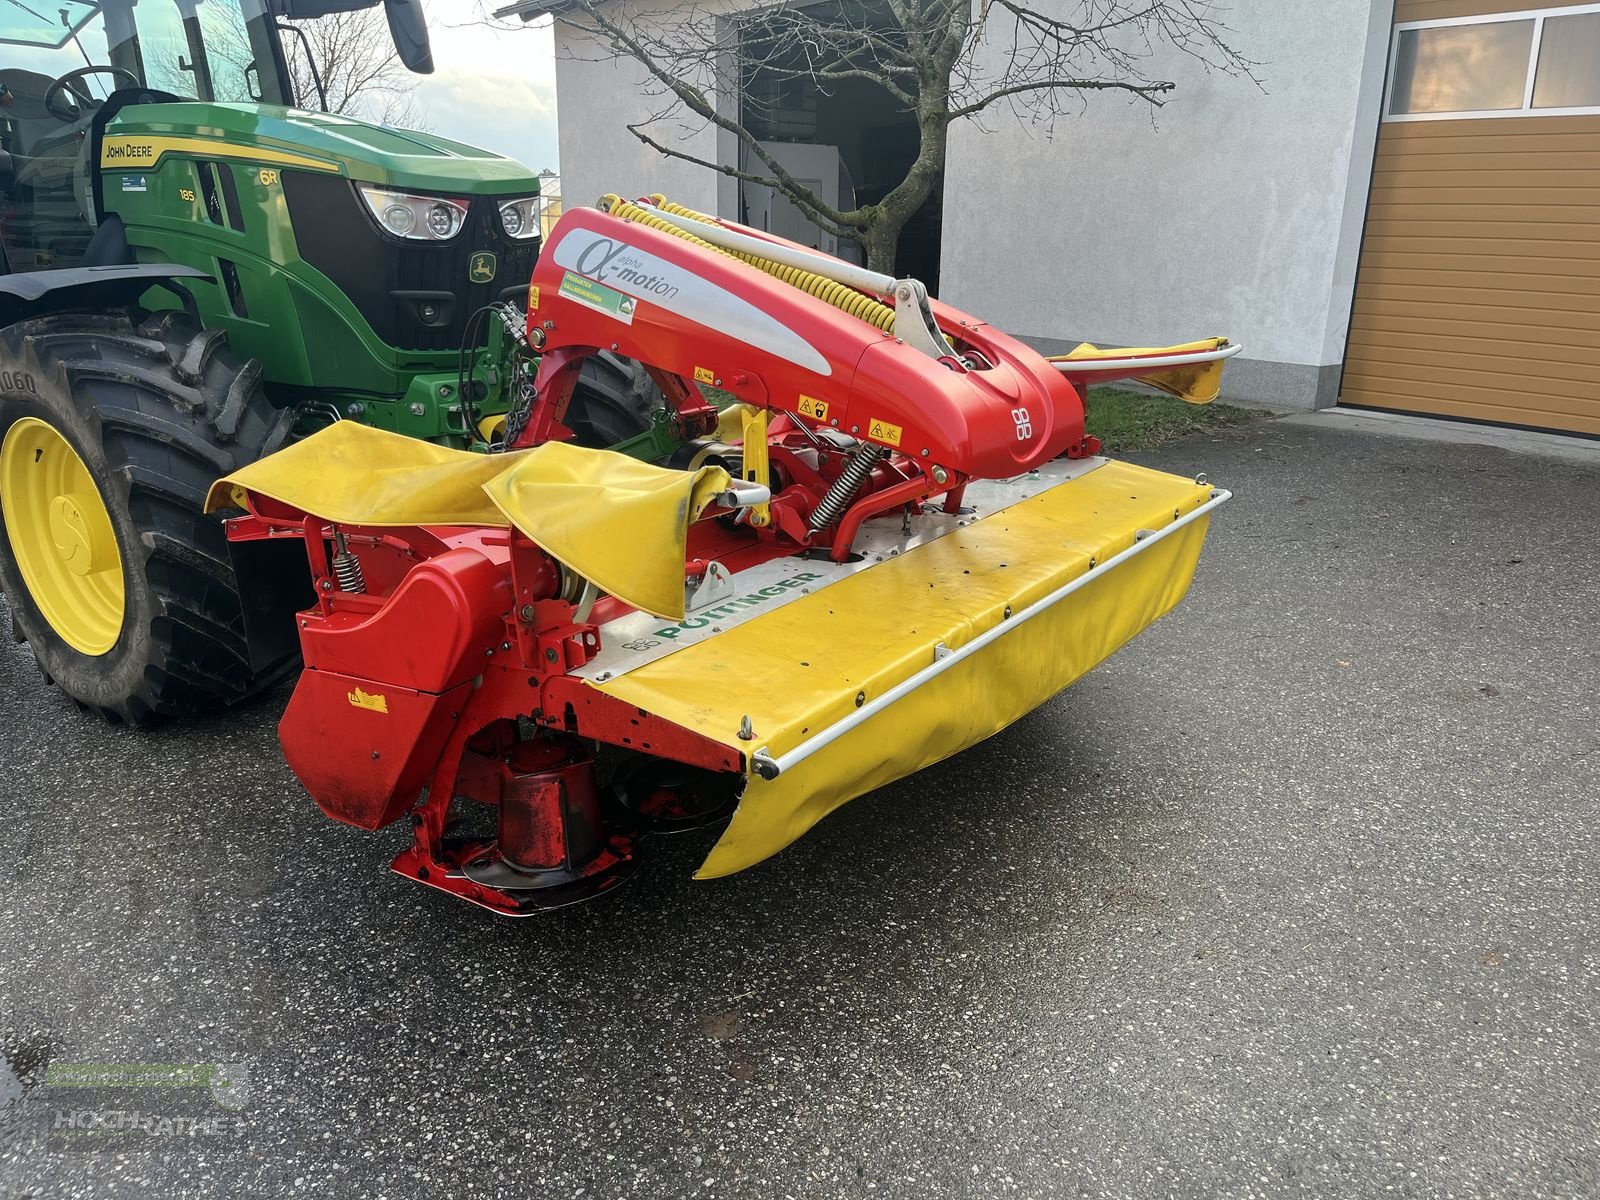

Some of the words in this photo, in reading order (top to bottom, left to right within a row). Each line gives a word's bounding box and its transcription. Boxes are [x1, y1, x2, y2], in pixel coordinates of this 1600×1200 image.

[126, 144, 152, 158] DEERE
[259, 169, 277, 185] 6R
[179, 189, 195, 202] 185
[618, 256, 643, 269] alpha
